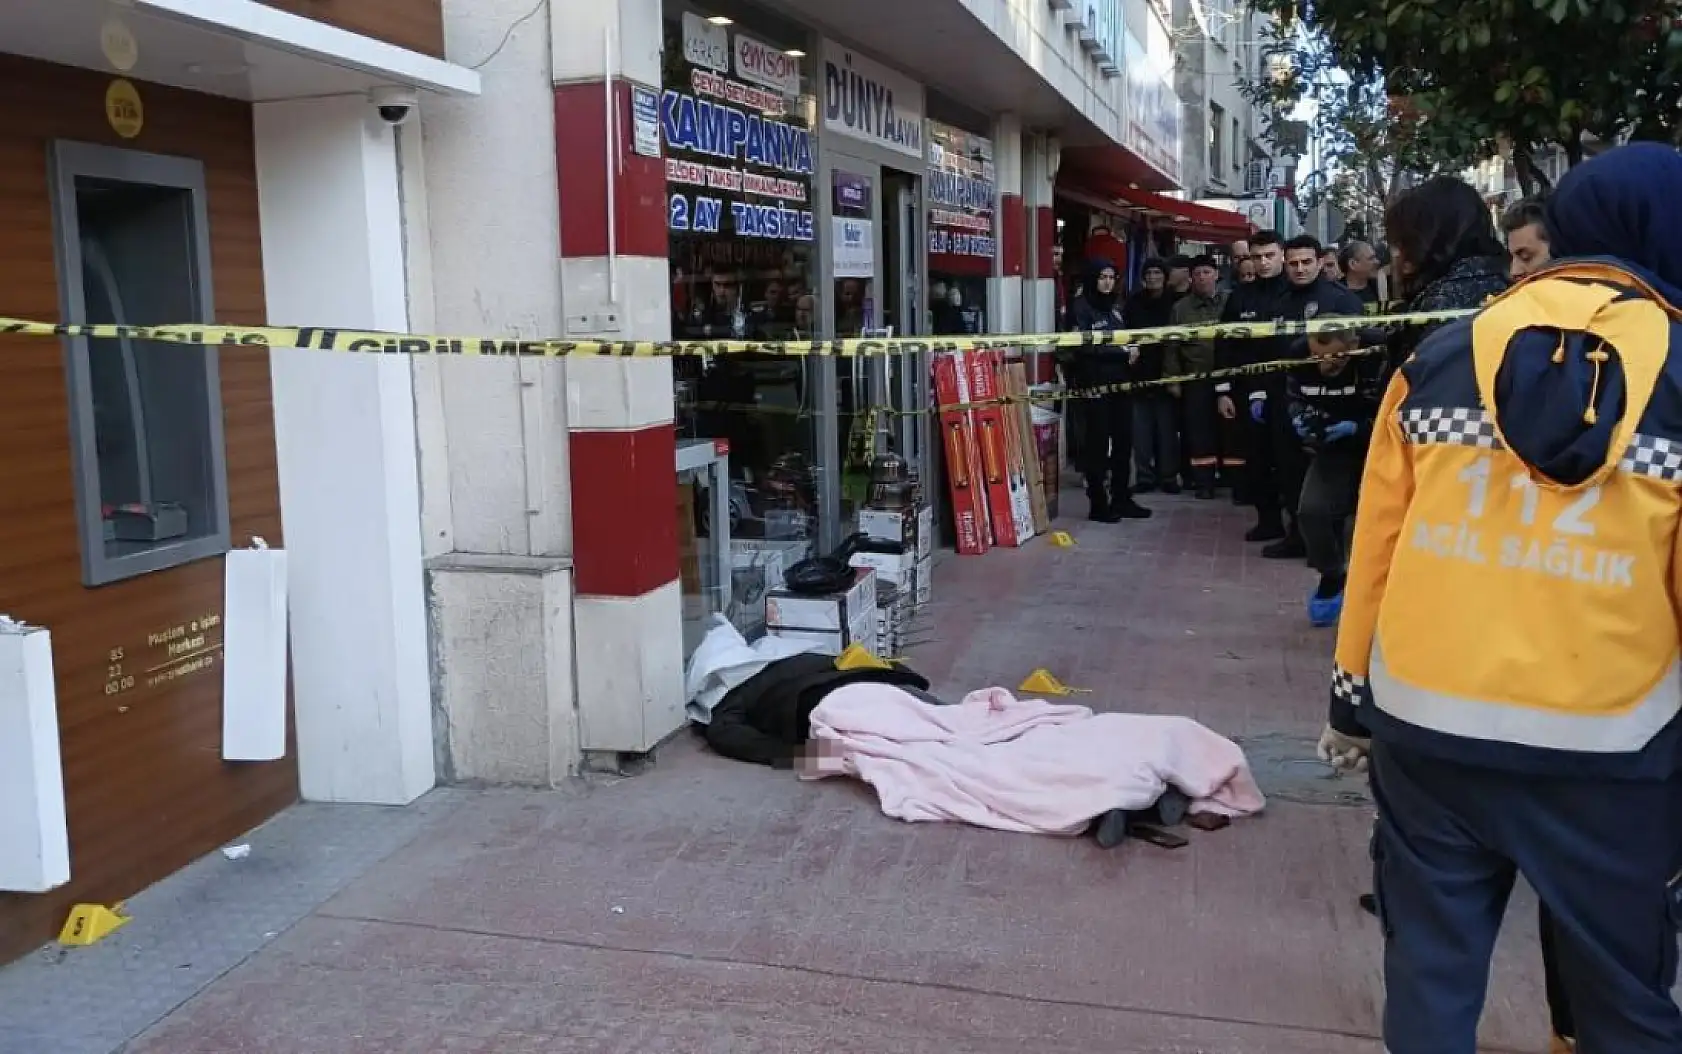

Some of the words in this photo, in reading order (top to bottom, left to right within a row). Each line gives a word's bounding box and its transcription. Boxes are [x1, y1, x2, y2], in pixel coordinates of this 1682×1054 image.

[660, 90, 814, 174] KAMPANYA
[825, 52, 894, 139] DÜNYA
[693, 196, 722, 233] AY
[731, 200, 814, 241] TAKSİTLE
[1459, 456, 1602, 536] 112
[1411, 517, 1487, 566] ACİL
[1500, 534, 1636, 588] SAĞLIK
